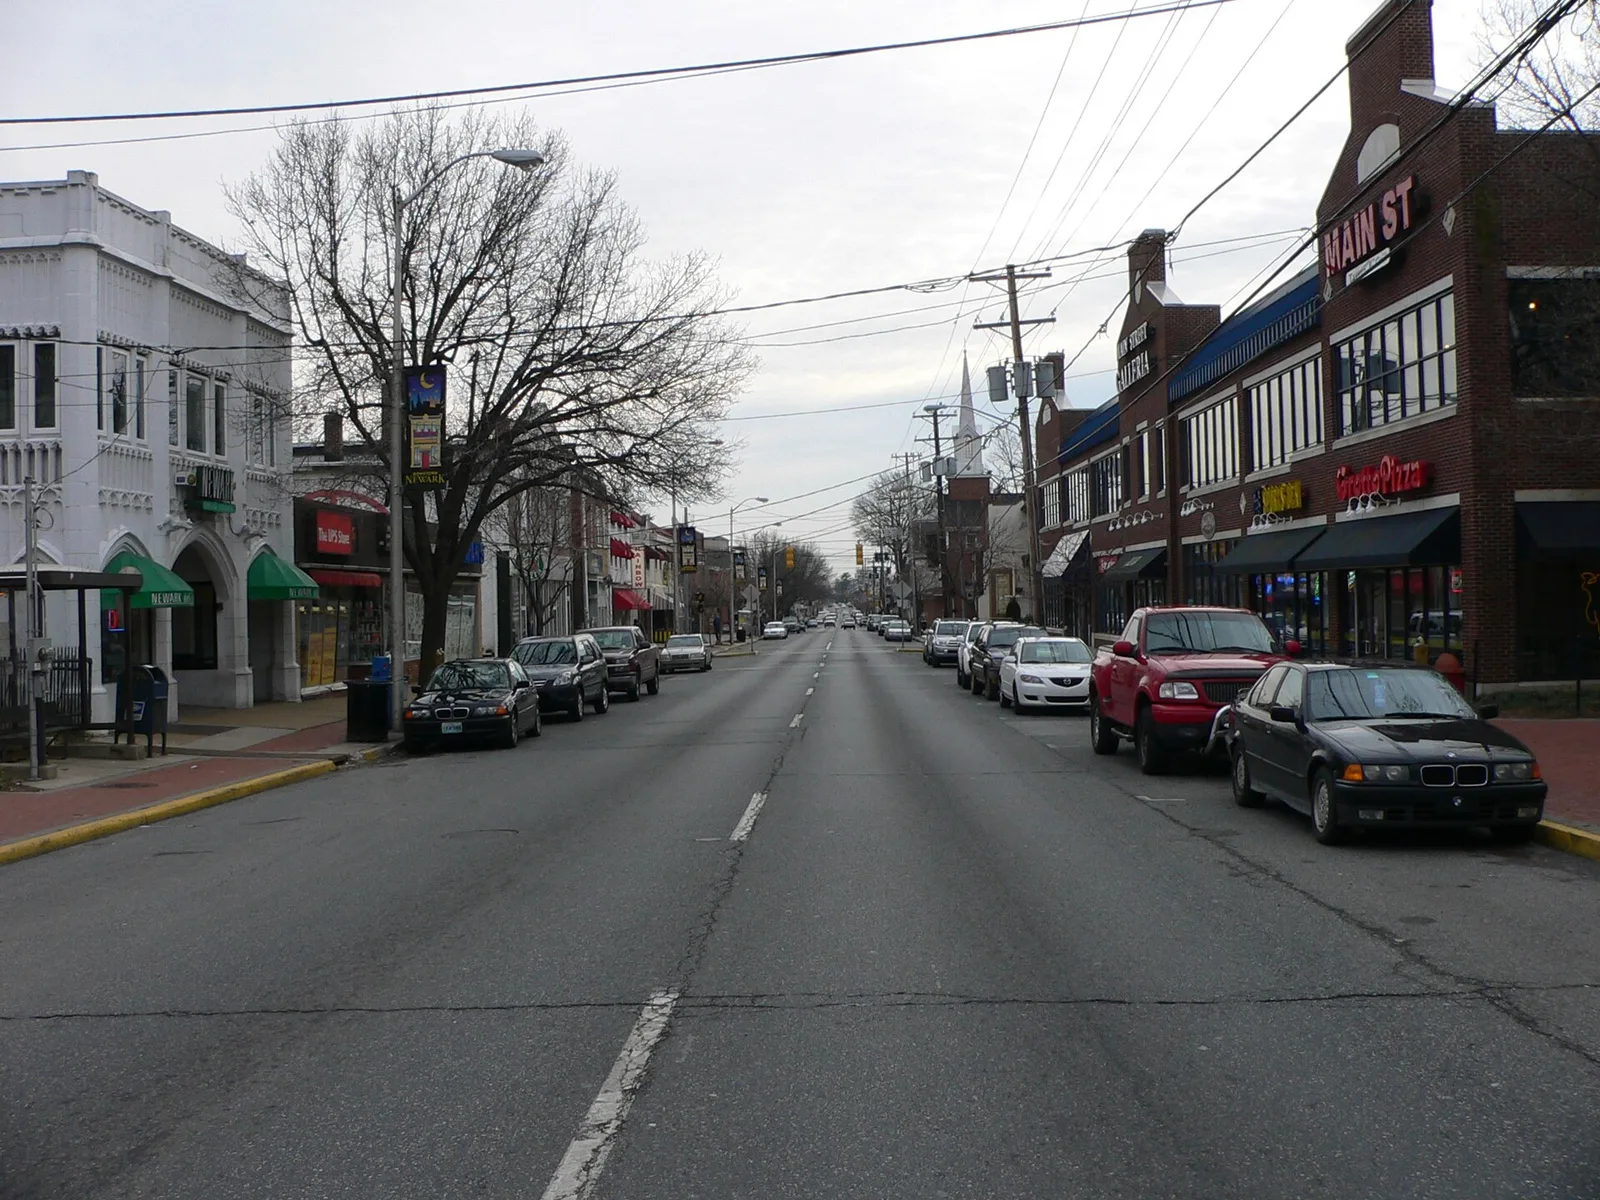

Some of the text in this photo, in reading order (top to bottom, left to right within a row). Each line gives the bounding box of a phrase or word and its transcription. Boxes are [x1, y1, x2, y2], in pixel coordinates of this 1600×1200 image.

[1324, 203, 1376, 278] MAIN
[1382, 175, 1413, 241] ST
[1116, 350, 1150, 392] GALLERIA
[202, 465, 234, 500] NEWARK
[405, 473, 446, 485] NEWARK
[1336, 465, 1381, 500] Grotto
[1380, 455, 1424, 494] Pizza
[318, 527, 350, 545] The UPS Store
[151, 592, 182, 604] NEWARK
